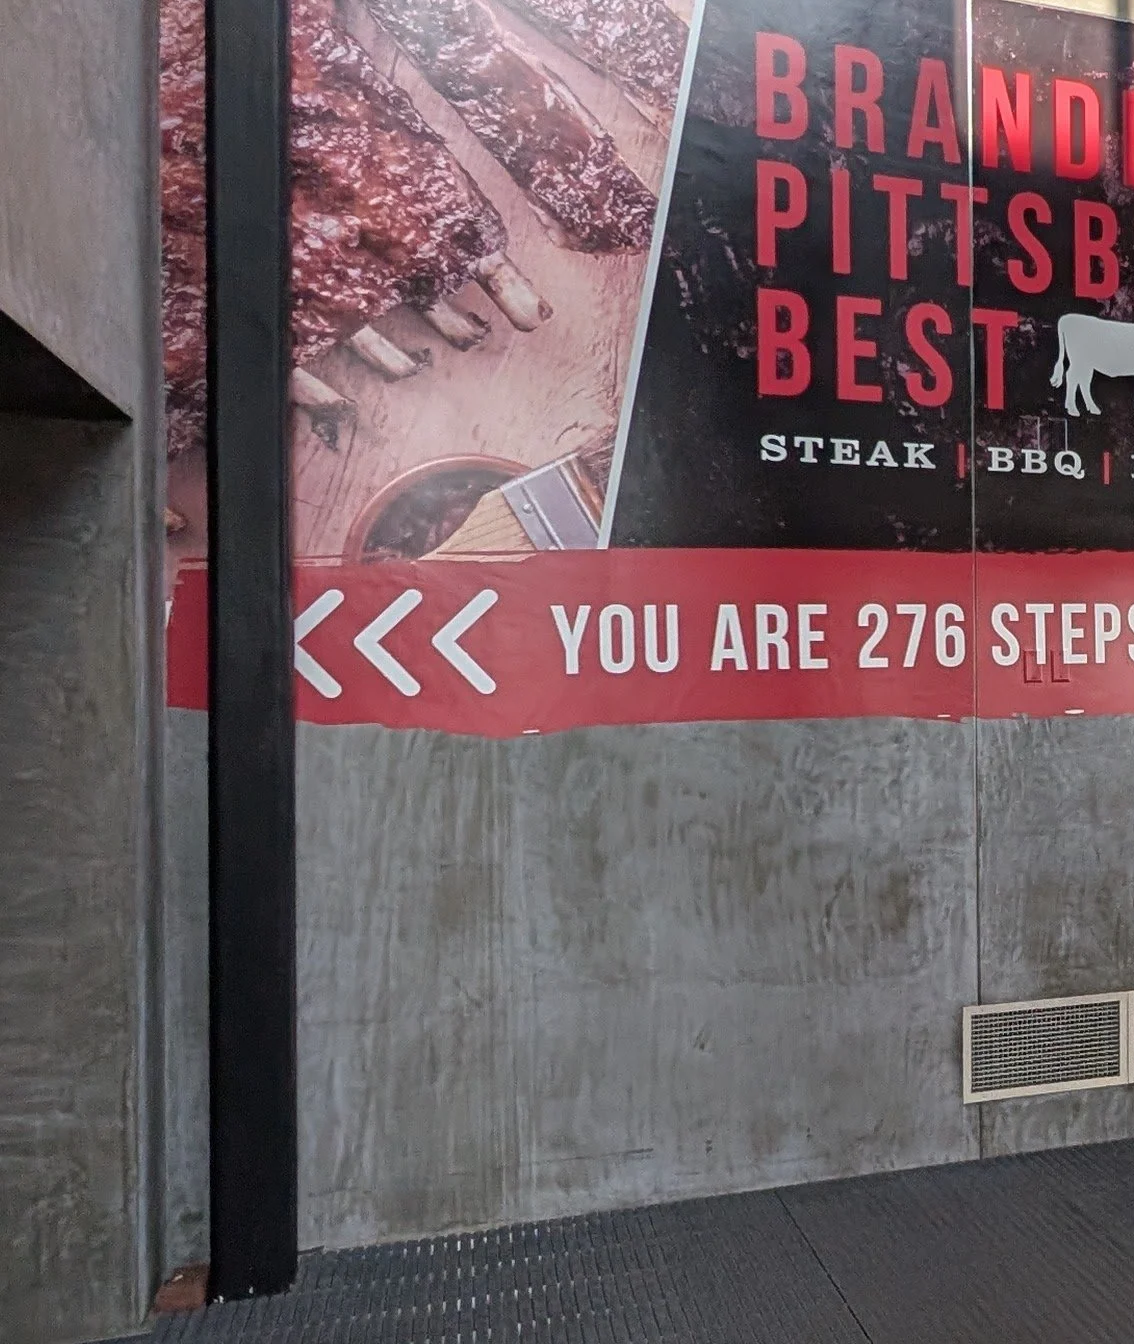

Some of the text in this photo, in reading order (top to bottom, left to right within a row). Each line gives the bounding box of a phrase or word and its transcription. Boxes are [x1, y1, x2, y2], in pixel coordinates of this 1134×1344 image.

[755, 288, 1020, 410] BEST
[760, 433, 937, 469] STEAK
[987, 445, 1087, 481] BBQ
[549, 603, 679, 675] YOU
[710, 603, 830, 671] ARE
[857, 603, 967, 669] 276
